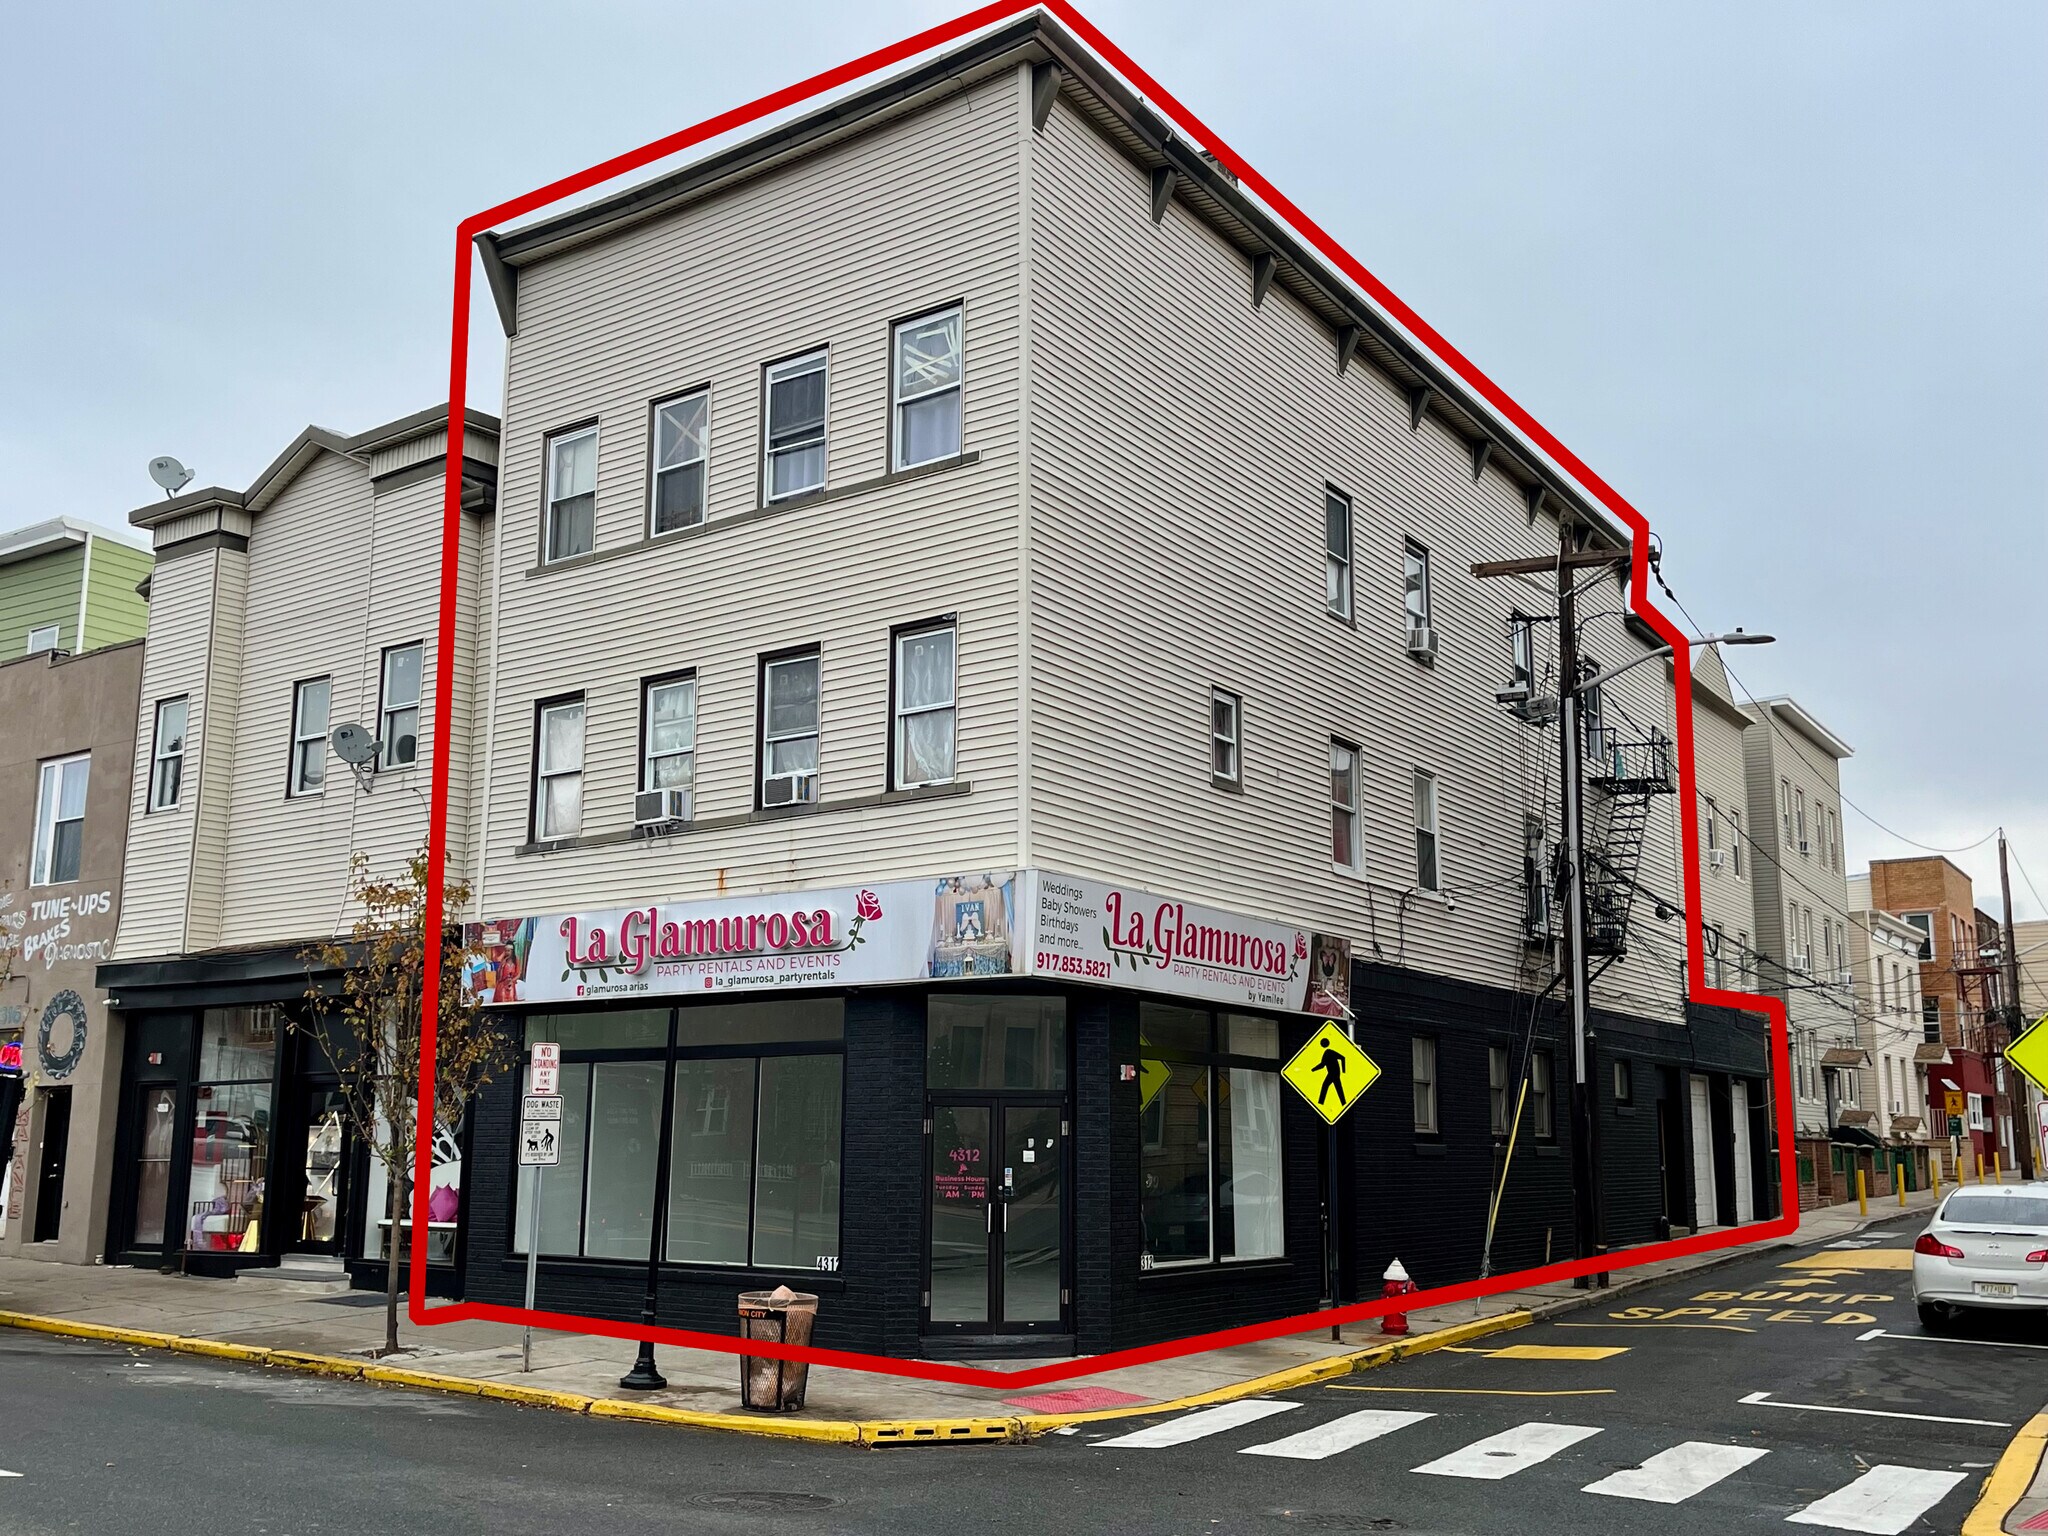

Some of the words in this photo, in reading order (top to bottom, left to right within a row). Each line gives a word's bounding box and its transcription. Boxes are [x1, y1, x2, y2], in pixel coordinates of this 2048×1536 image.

[1042, 880, 1083, 901] Weddings
[961, 903, 980, 912] IVAN
[1041, 897, 1062, 914] Baby
[1063, 902, 1097, 918] Showers
[1040, 914, 1079, 934] Birthdays
[24, 918, 70, 961] BRAKES
[560, 917, 609, 963] La
[620, 907, 835, 975] Glamurosa
[1039, 933, 1056, 945] and
[1105, 892, 1144, 949] La
[1153, 903, 1287, 975] Glamurosa
[656, 963, 695, 977] PARTY
[699, 960, 753, 974] RENTALS
[757, 958, 786, 970] AND
[790, 954, 841, 969] EVENTS
[1037, 952, 1111, 979] 917.853.5821
[715, 970, 835, 988] la_glamurosa_partyrentals
[1173, 963, 1200, 978] PARTY
[1202, 967, 1237, 985] RENTALS
[1238, 973, 1255, 989] AND
[1257, 977, 1286, 993] EVENTS
[586, 984, 628, 996] glamurosa
[629, 981, 649, 992] arias
[1248, 991, 1256, 1003] by
[1257, 992, 1284, 1004] Yamilee
[541, 1047, 552, 1057] NO
[534, 1059, 557, 1069] STANDING
[539, 1078, 550, 1086] TIME
[526, 1100, 539, 1109] DOG
[541, 1100, 559, 1109] WASTE
[949, 1149, 980, 1161] 4312
[1689, 1291, 1894, 1304] BUMP
[750, 1310, 767, 1318] CITY
[1608, 1307, 1877, 1324] SPEED
